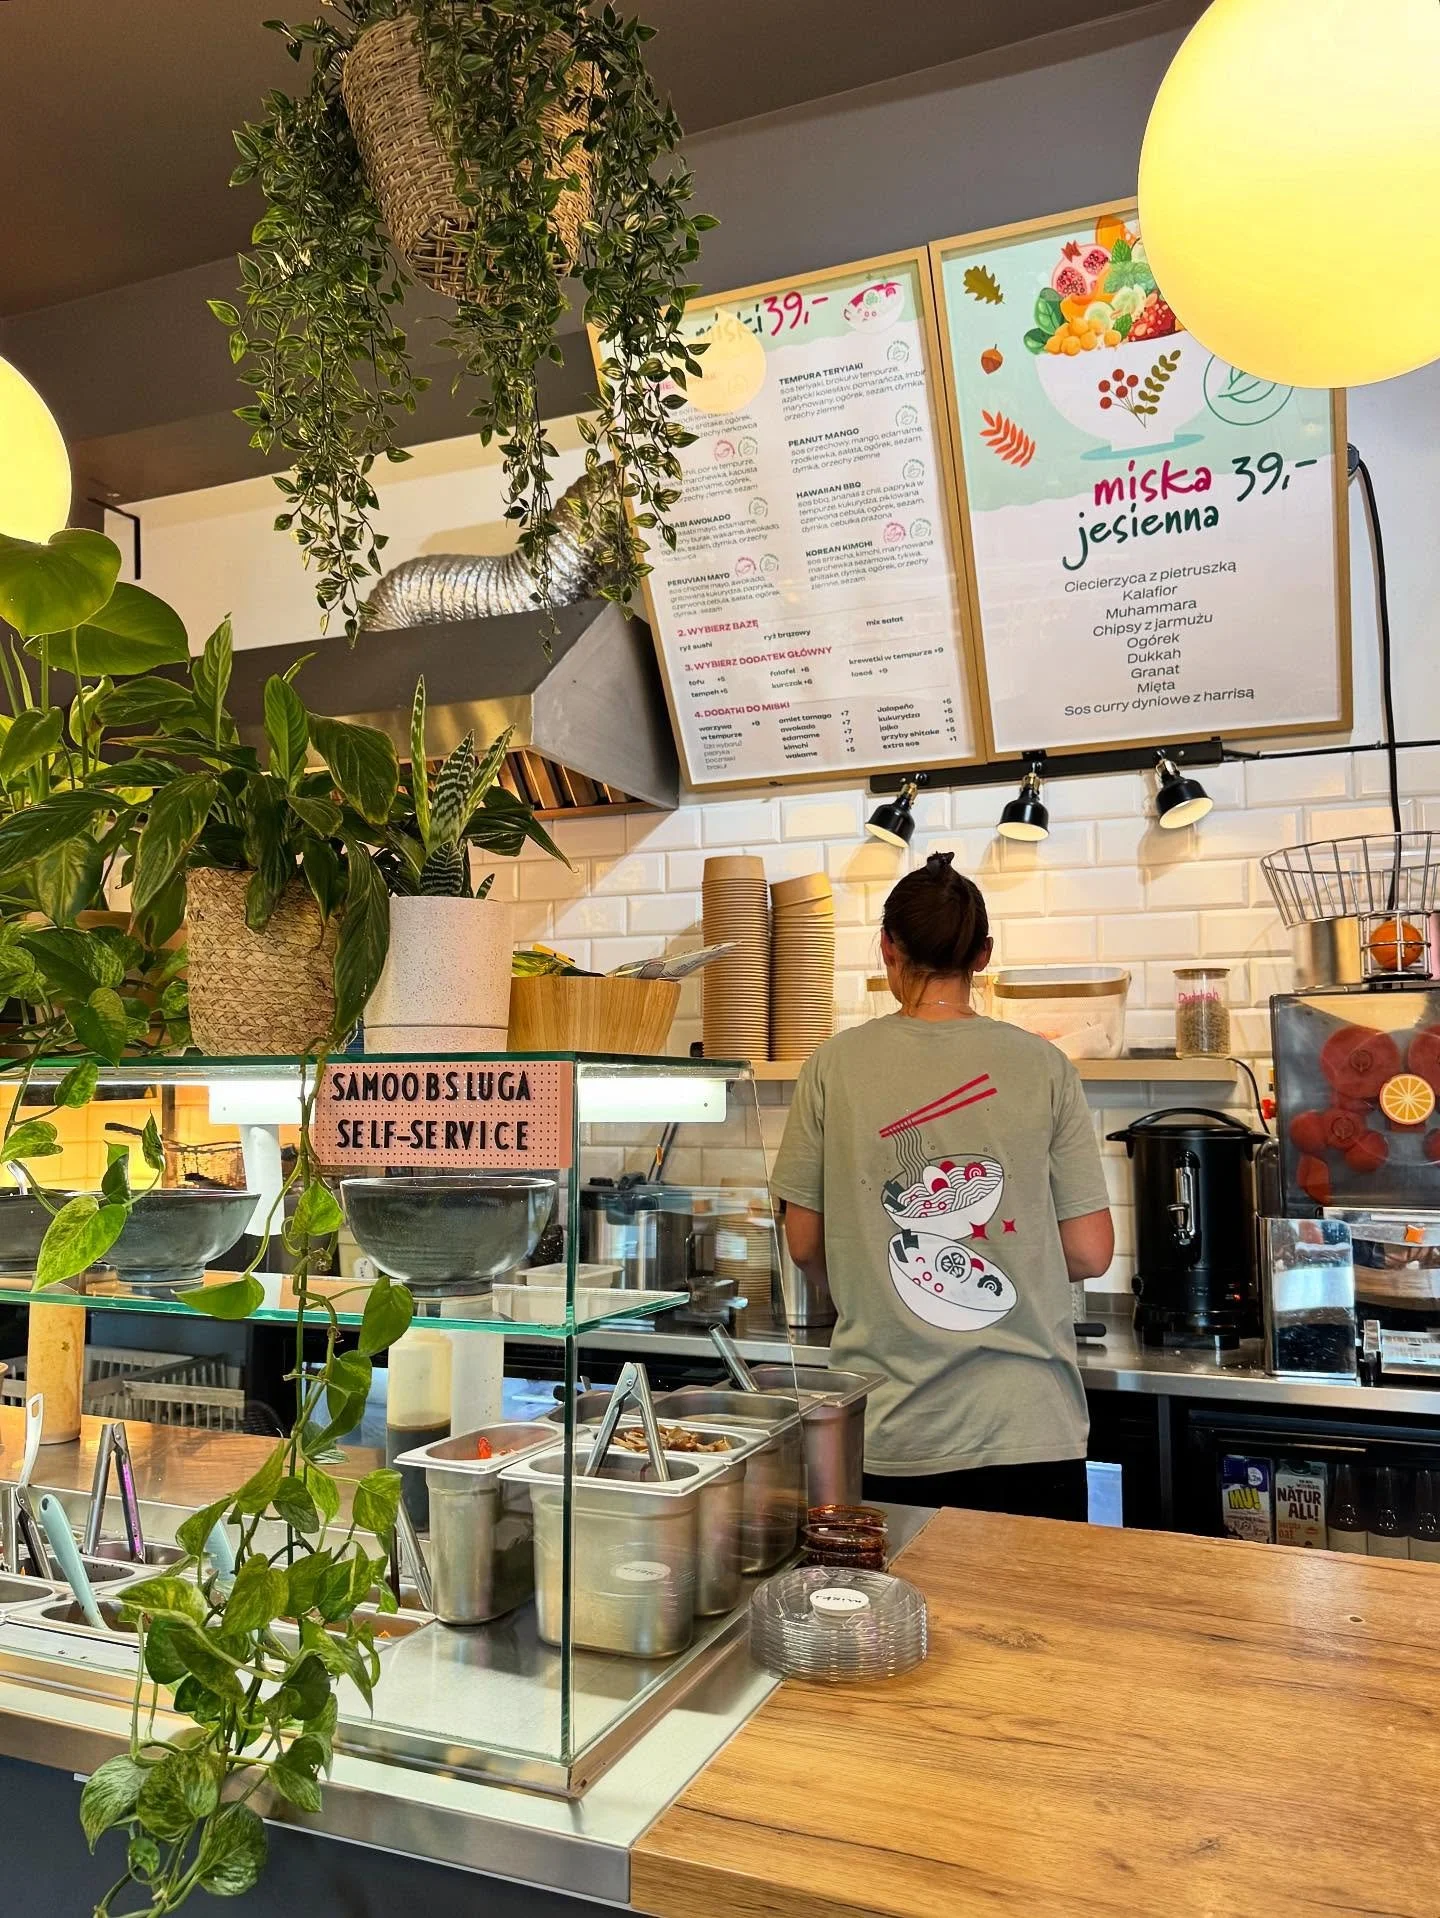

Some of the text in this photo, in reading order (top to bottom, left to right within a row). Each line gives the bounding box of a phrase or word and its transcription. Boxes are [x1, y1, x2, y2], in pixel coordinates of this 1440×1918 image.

[764, 291, 829, 336] 39,-
[779, 363, 863, 385] TEMPURA TERYIAKI
[788, 428, 859, 447] PEANUT MANGO
[791, 448, 805, 456] sos
[1095, 452, 1317, 506] miska 39,-
[796, 481, 861, 499] HAWAIIAN BBQ
[797, 499, 812, 508] sos
[656, 514, 731, 532] WSABI AWOKADO
[1062, 503, 1219, 570] jesienna
[805, 541, 872, 557] KOREAN KIMCHI
[667, 572, 730, 587] PERUVIAN MAYO
[1064, 561, 1237, 593] Ciecierzyca z pietruszką
[1123, 585, 1178, 601] Kalafior
[1106, 600, 1197, 619] Muhammara
[686, 623, 731, 635] WYBIERZ
[732, 619, 759, 630] BAZĘ
[1093, 613, 1213, 637] Chipsy z jarmużu
[679, 641, 712, 652] ryż sushi
[1127, 633, 1180, 649] Ogórek
[693, 658, 738, 670] WYBIERZ
[739, 652, 786, 665] DODATEK
[787, 646, 832, 658] GŁÓWNY
[848, 655, 883, 664] krewetki
[1128, 649, 1181, 664] Dukkah
[1131, 664, 1180, 678] Granat
[1137, 680, 1175, 693] Mięta
[1064, 688, 1255, 716] Sos curry dyniowe z harrisą
[704, 706, 745, 717] DODATKI
[802, 713, 832, 721] tamago
[878, 713, 920, 722] kukurydza
[780, 723, 816, 732] awokado
[708, 732, 742, 740] tempurze
[782, 733, 820, 741] edamame
[881, 732, 908, 741] grzyby
[783, 742, 808, 750] kimchi
[785, 751, 817, 759] wakame
[331, 1071, 531, 1101] SAMOOBSLUGA
[336, 1119, 529, 1151] SELF-SERVICE
[1288, 1502, 1319, 1521] ALL!
